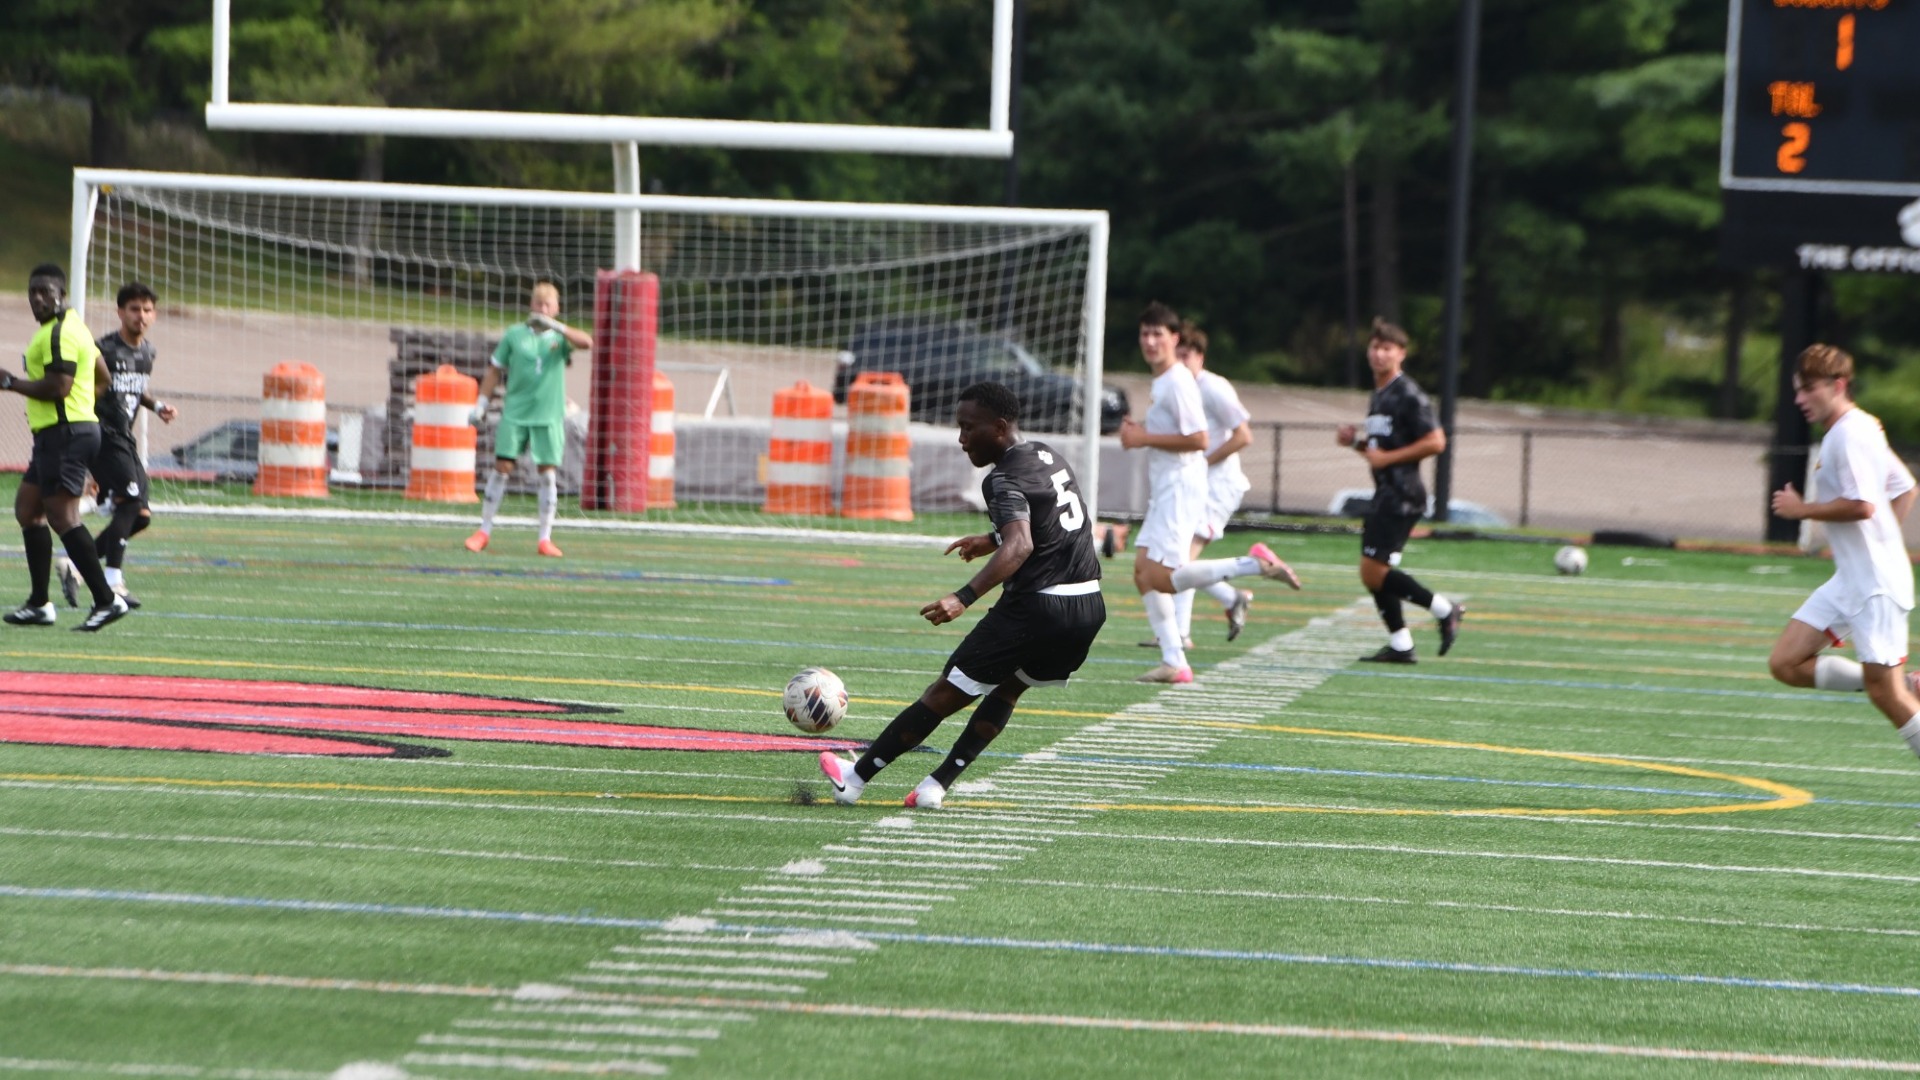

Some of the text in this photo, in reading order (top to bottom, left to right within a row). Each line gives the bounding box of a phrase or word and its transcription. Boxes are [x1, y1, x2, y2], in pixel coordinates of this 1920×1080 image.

[1836, 14, 1855, 70] 1
[1777, 122, 1811, 173] 2
[1050, 469, 1084, 532] 5
